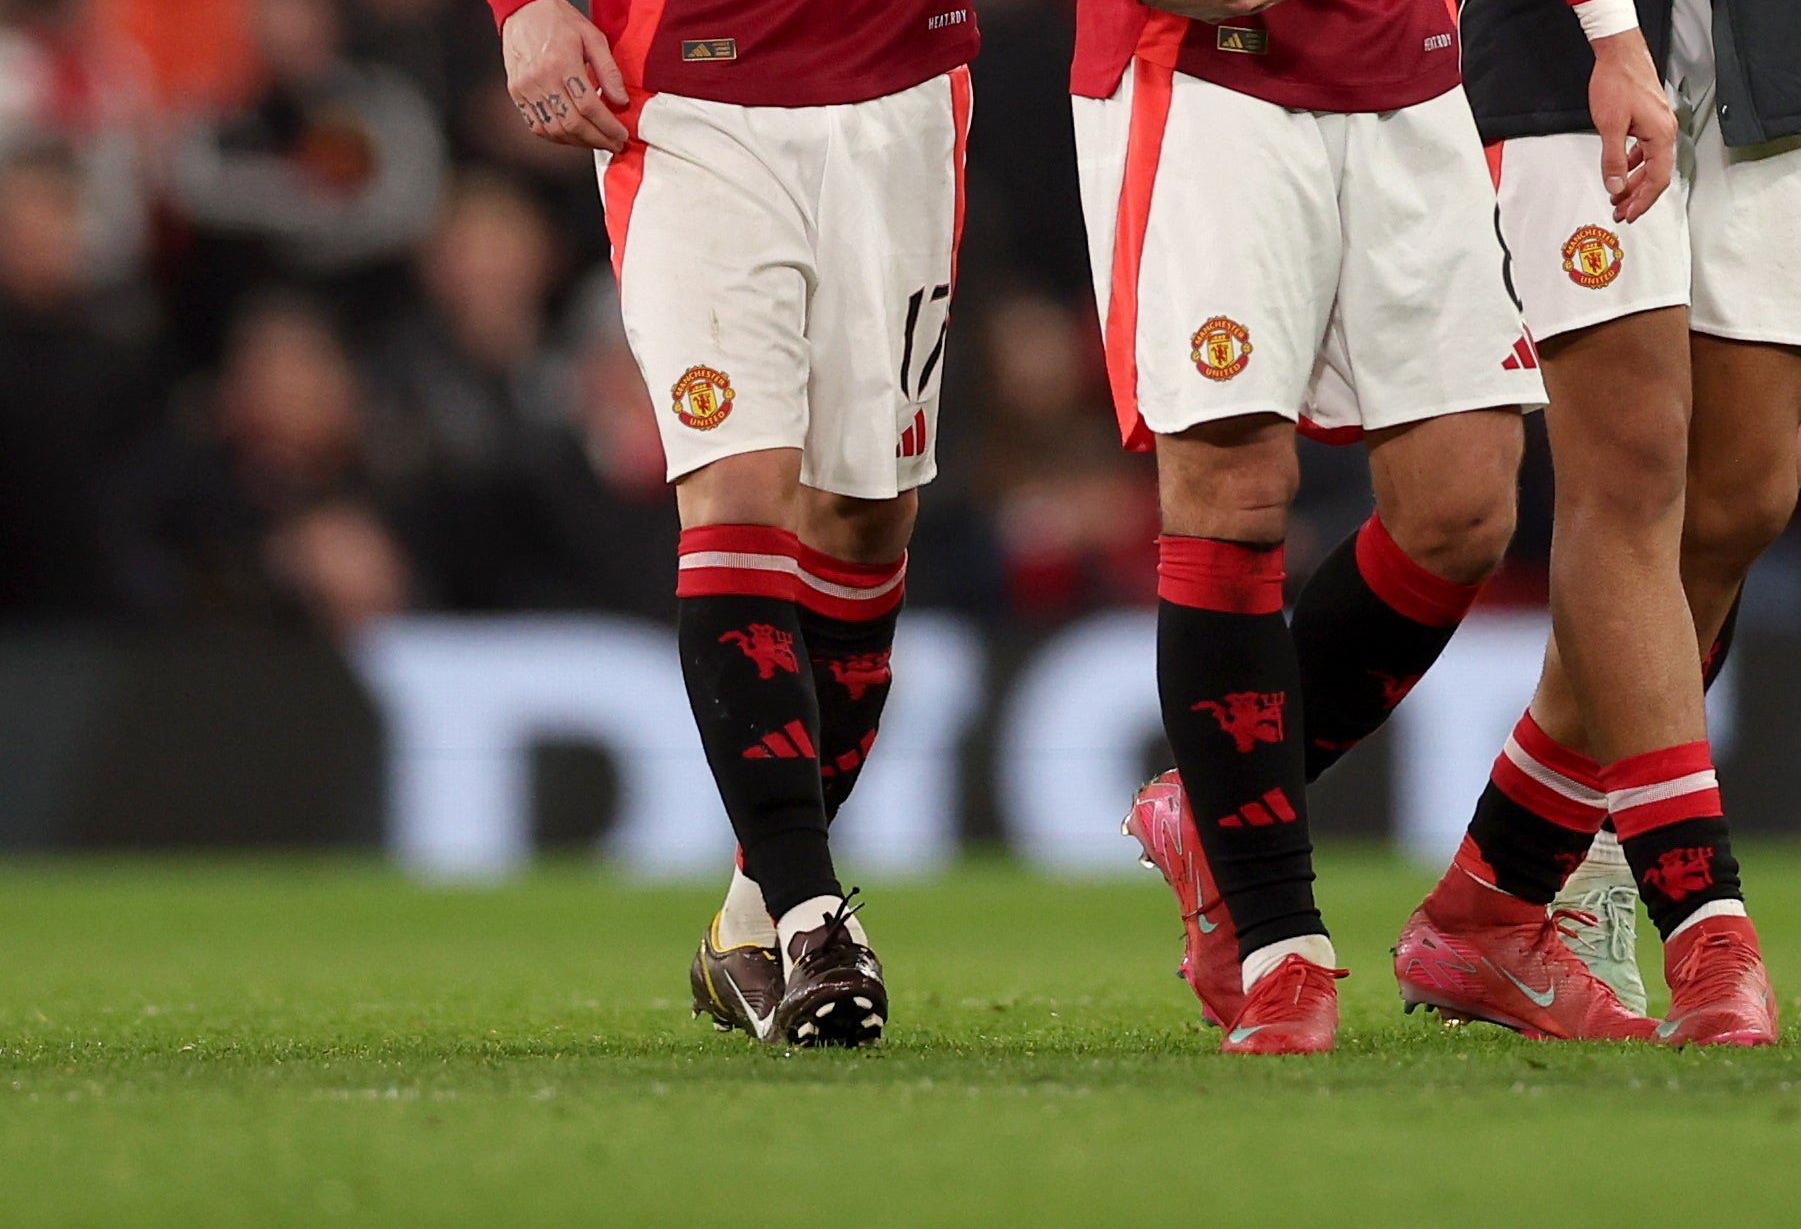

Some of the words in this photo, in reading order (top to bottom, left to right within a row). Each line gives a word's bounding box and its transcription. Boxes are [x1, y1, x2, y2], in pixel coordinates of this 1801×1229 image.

[1580, 270, 1615, 285] UNITED
[900, 282, 950, 403] 17
[690, 411, 725, 426] UNITED
